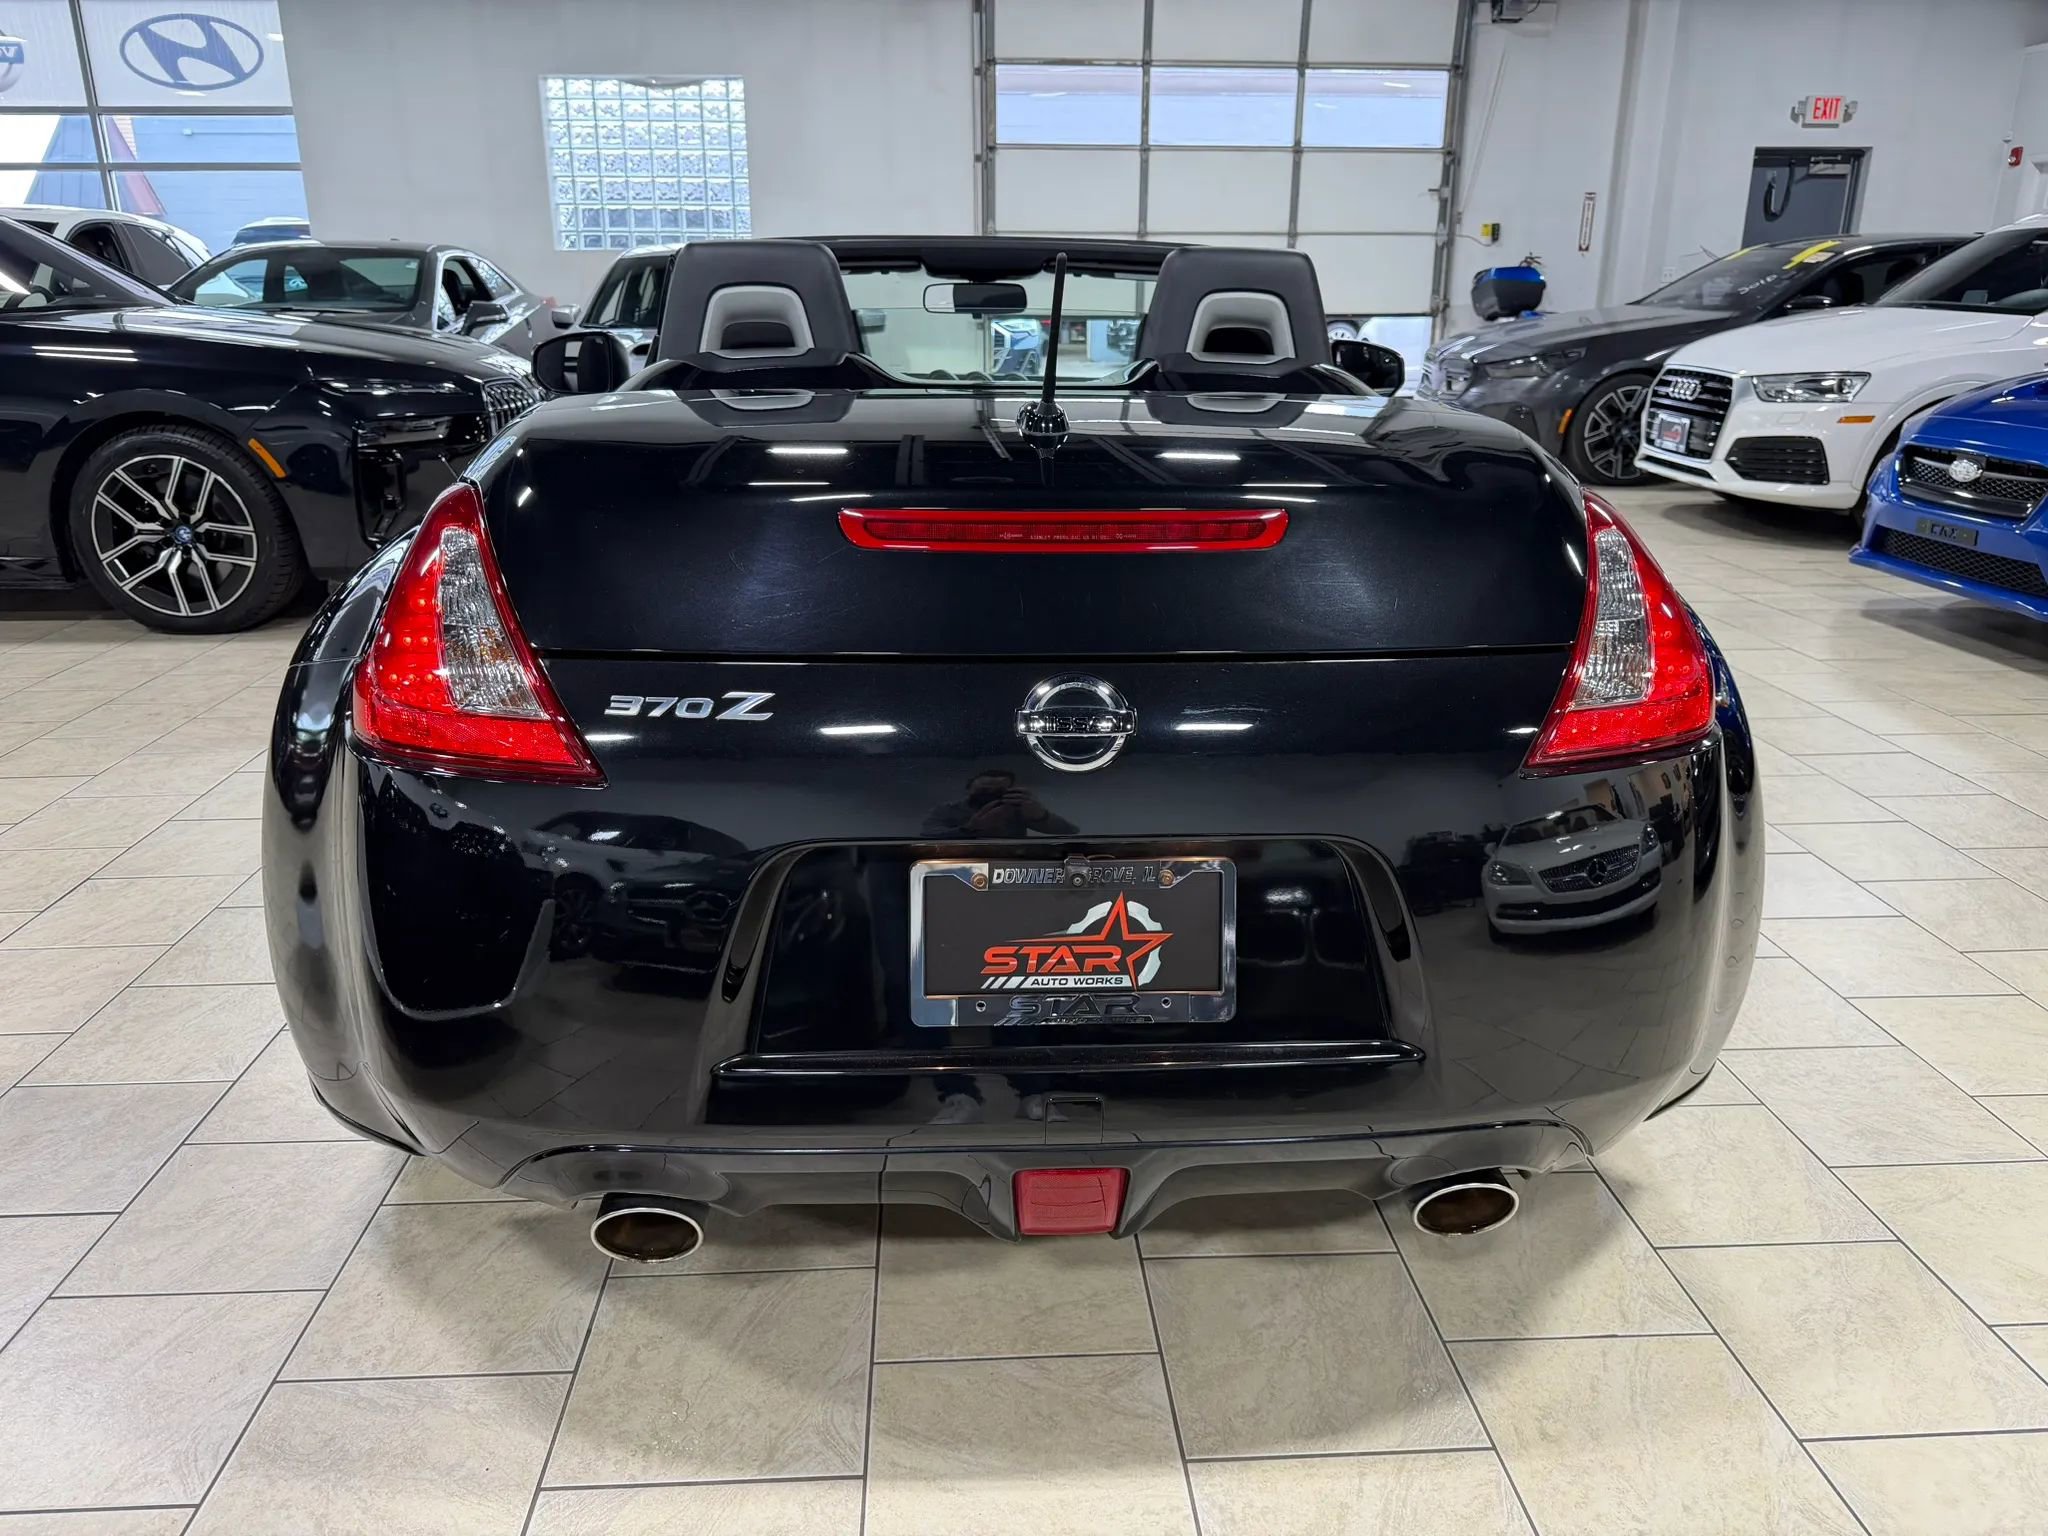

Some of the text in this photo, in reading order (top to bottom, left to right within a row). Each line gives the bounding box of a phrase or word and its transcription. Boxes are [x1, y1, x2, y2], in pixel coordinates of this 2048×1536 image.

[1813, 97, 1841, 120] EXIT
[604, 692, 776, 721] 370Z
[991, 866, 1157, 884] DOWNER ROVE, IL
[980, 945, 1122, 974] STAR
[1031, 976, 1124, 986] AUTO WORKS
[1006, 993, 1141, 1017] STAR
